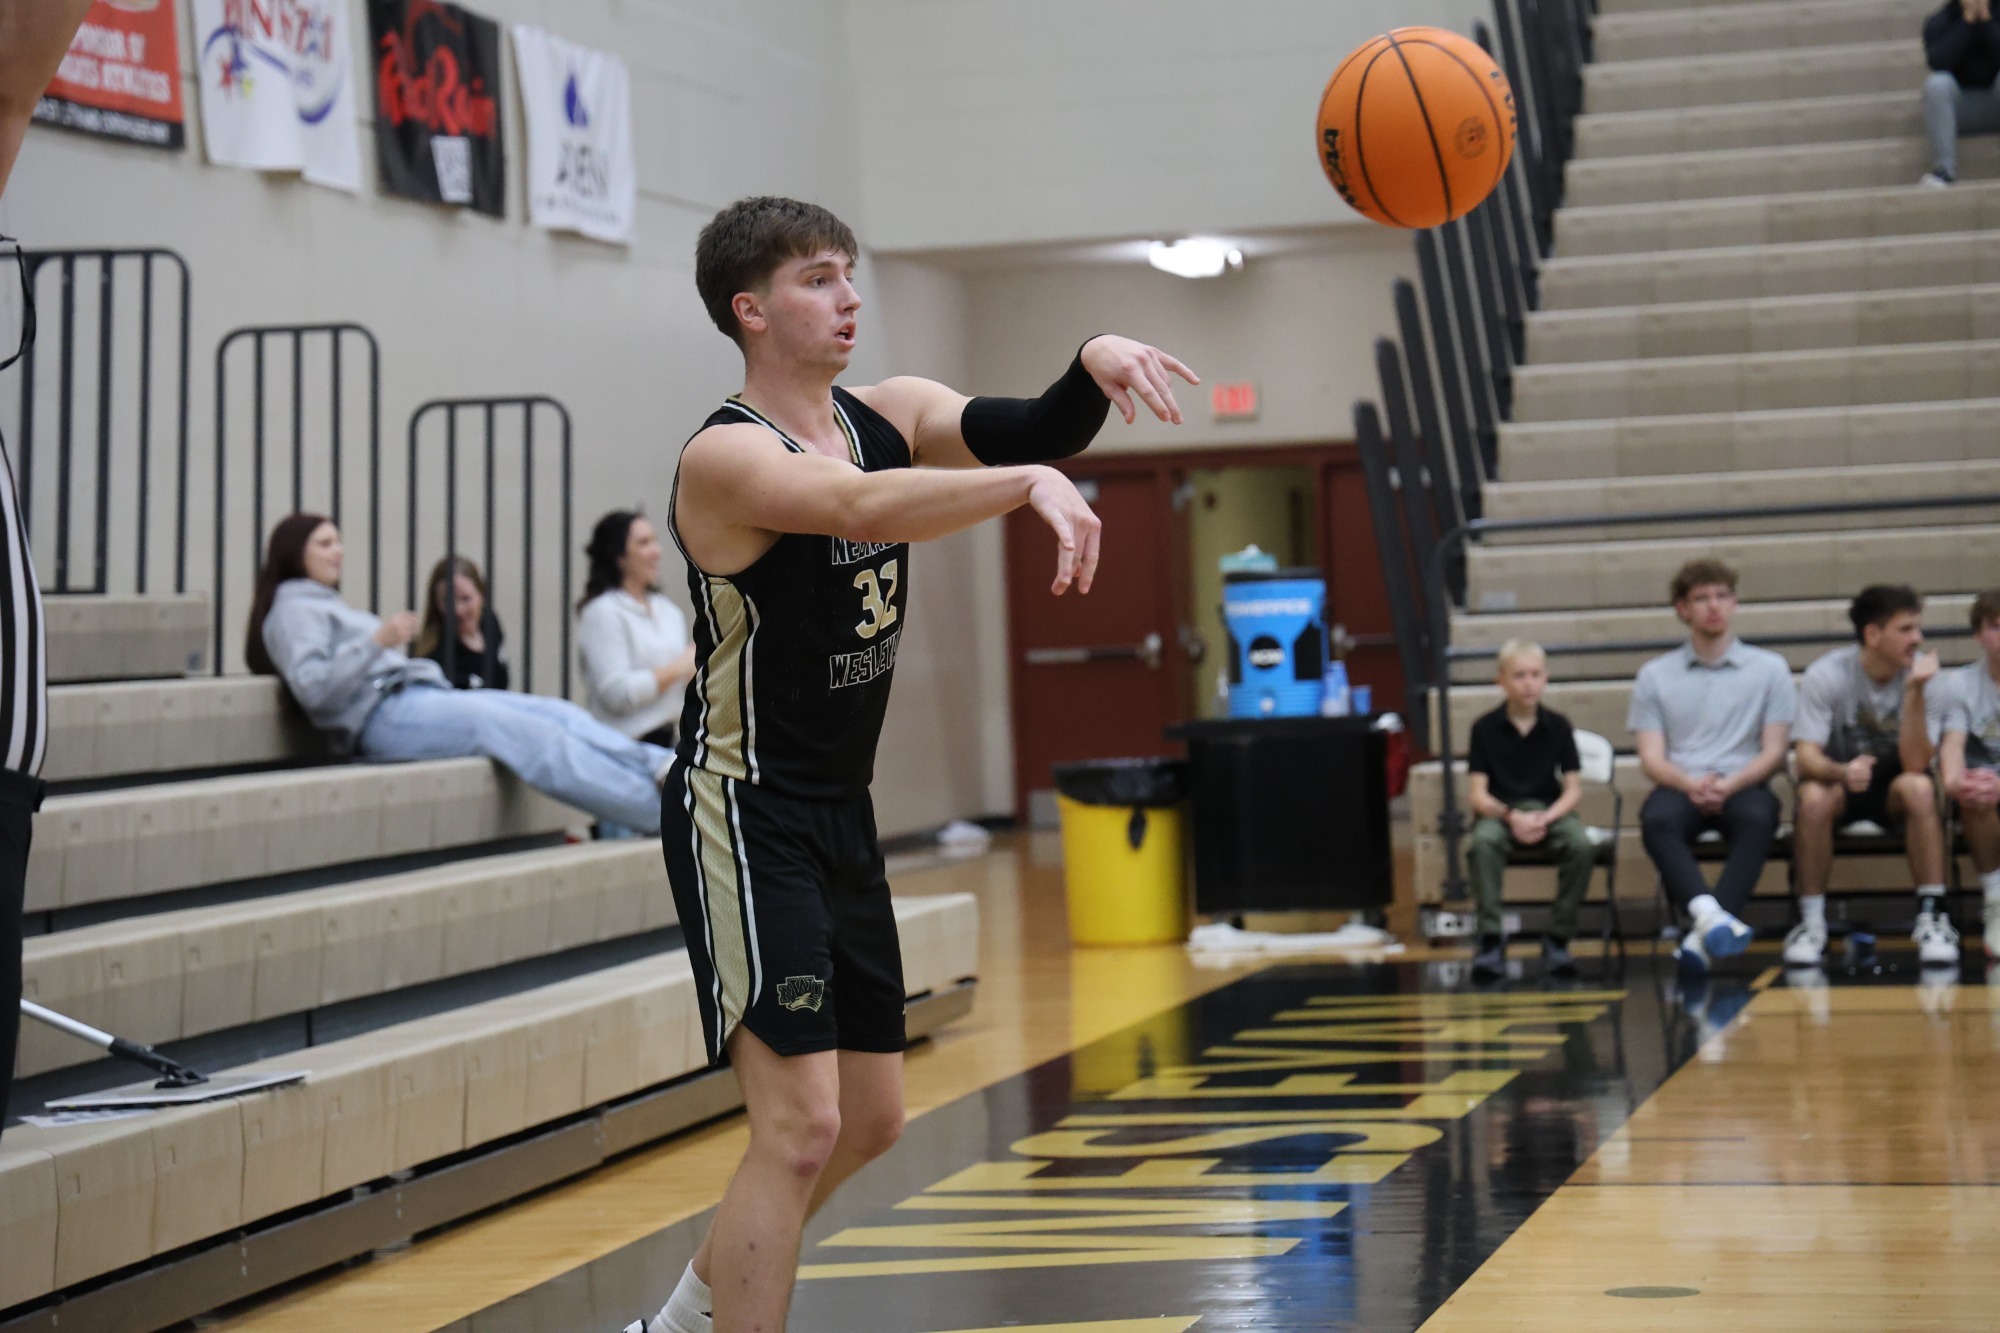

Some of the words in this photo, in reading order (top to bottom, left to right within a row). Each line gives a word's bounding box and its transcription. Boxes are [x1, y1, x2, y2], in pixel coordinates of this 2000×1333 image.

[853, 559, 898, 638] 32
[829, 624, 901, 688] WESLEY
[777, 975, 824, 1005] NWU
